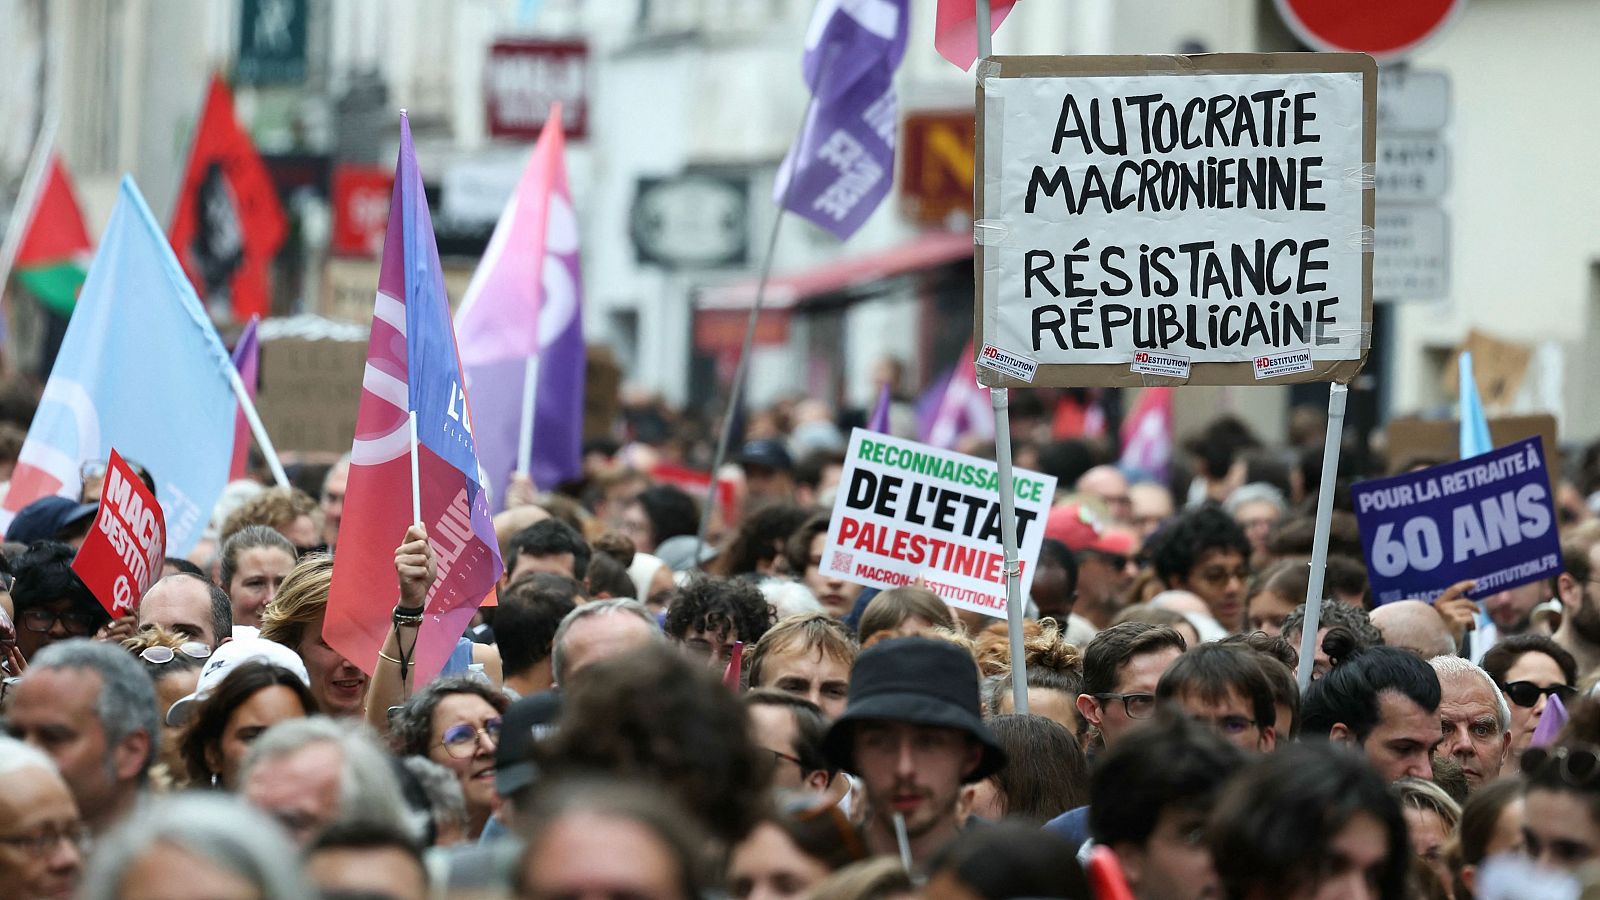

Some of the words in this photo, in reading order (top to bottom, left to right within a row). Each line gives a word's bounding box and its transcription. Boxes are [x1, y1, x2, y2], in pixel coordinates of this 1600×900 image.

[845, 467, 903, 518] DE
[1358, 489, 1414, 514] POUR
[1414, 481, 1441, 503] LA
[1442, 458, 1526, 496] RETRAITE
[1525, 443, 1541, 470] À
[1371, 515, 1444, 578] 60
[1453, 482, 1552, 564] ANS
